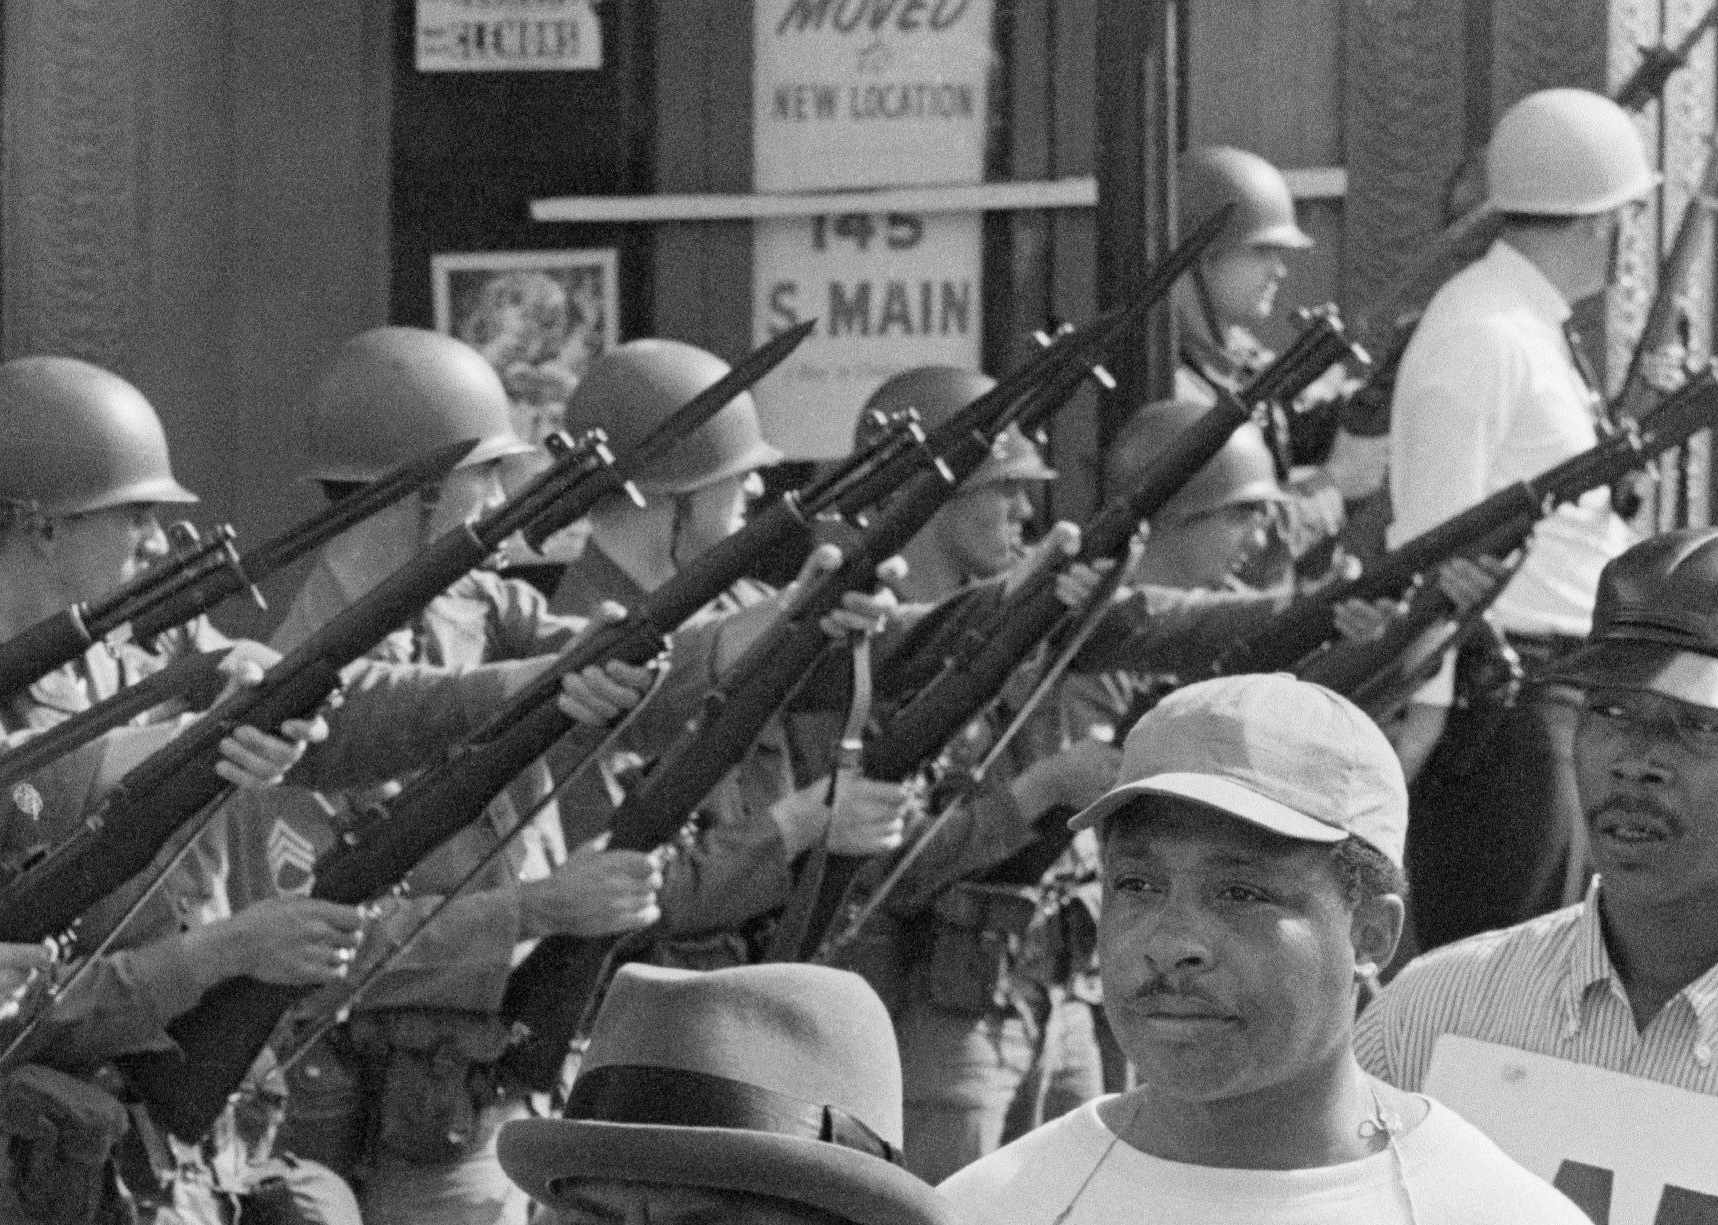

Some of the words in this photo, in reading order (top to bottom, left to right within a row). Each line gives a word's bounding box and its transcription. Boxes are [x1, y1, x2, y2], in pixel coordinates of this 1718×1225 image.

[775, 83, 835, 121] NEW
[849, 83, 974, 119] LOCATION
[828, 279, 971, 337] MAIN
